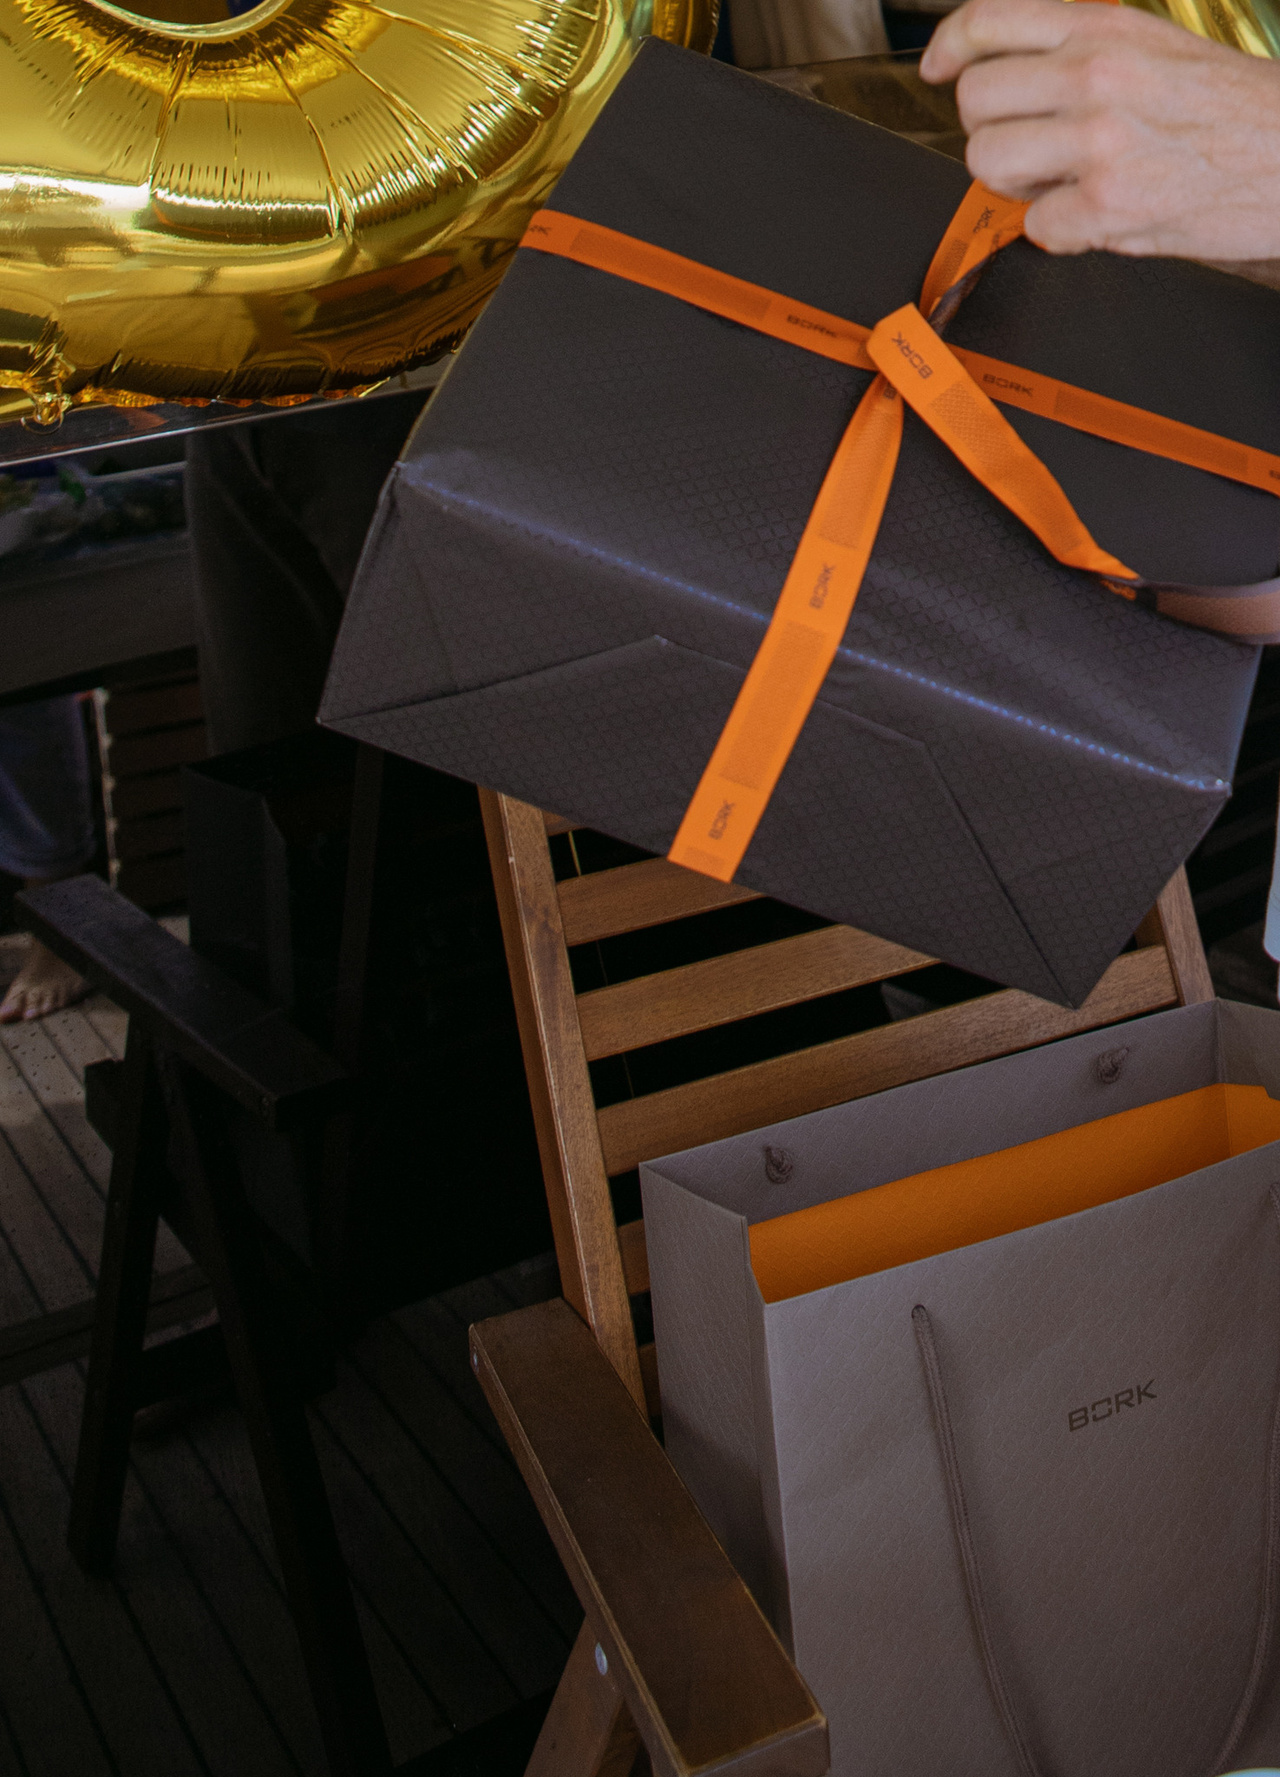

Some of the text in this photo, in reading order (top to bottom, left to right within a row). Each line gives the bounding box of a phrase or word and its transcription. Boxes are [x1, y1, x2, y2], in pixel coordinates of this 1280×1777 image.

[786, 314, 838, 339] BORK
[891, 331, 934, 380] BORK
[982, 373, 1034, 398] BORK
[808, 562, 837, 610] BORK
[707, 799, 736, 841] BORK
[1067, 1378, 1158, 1433] BORK
